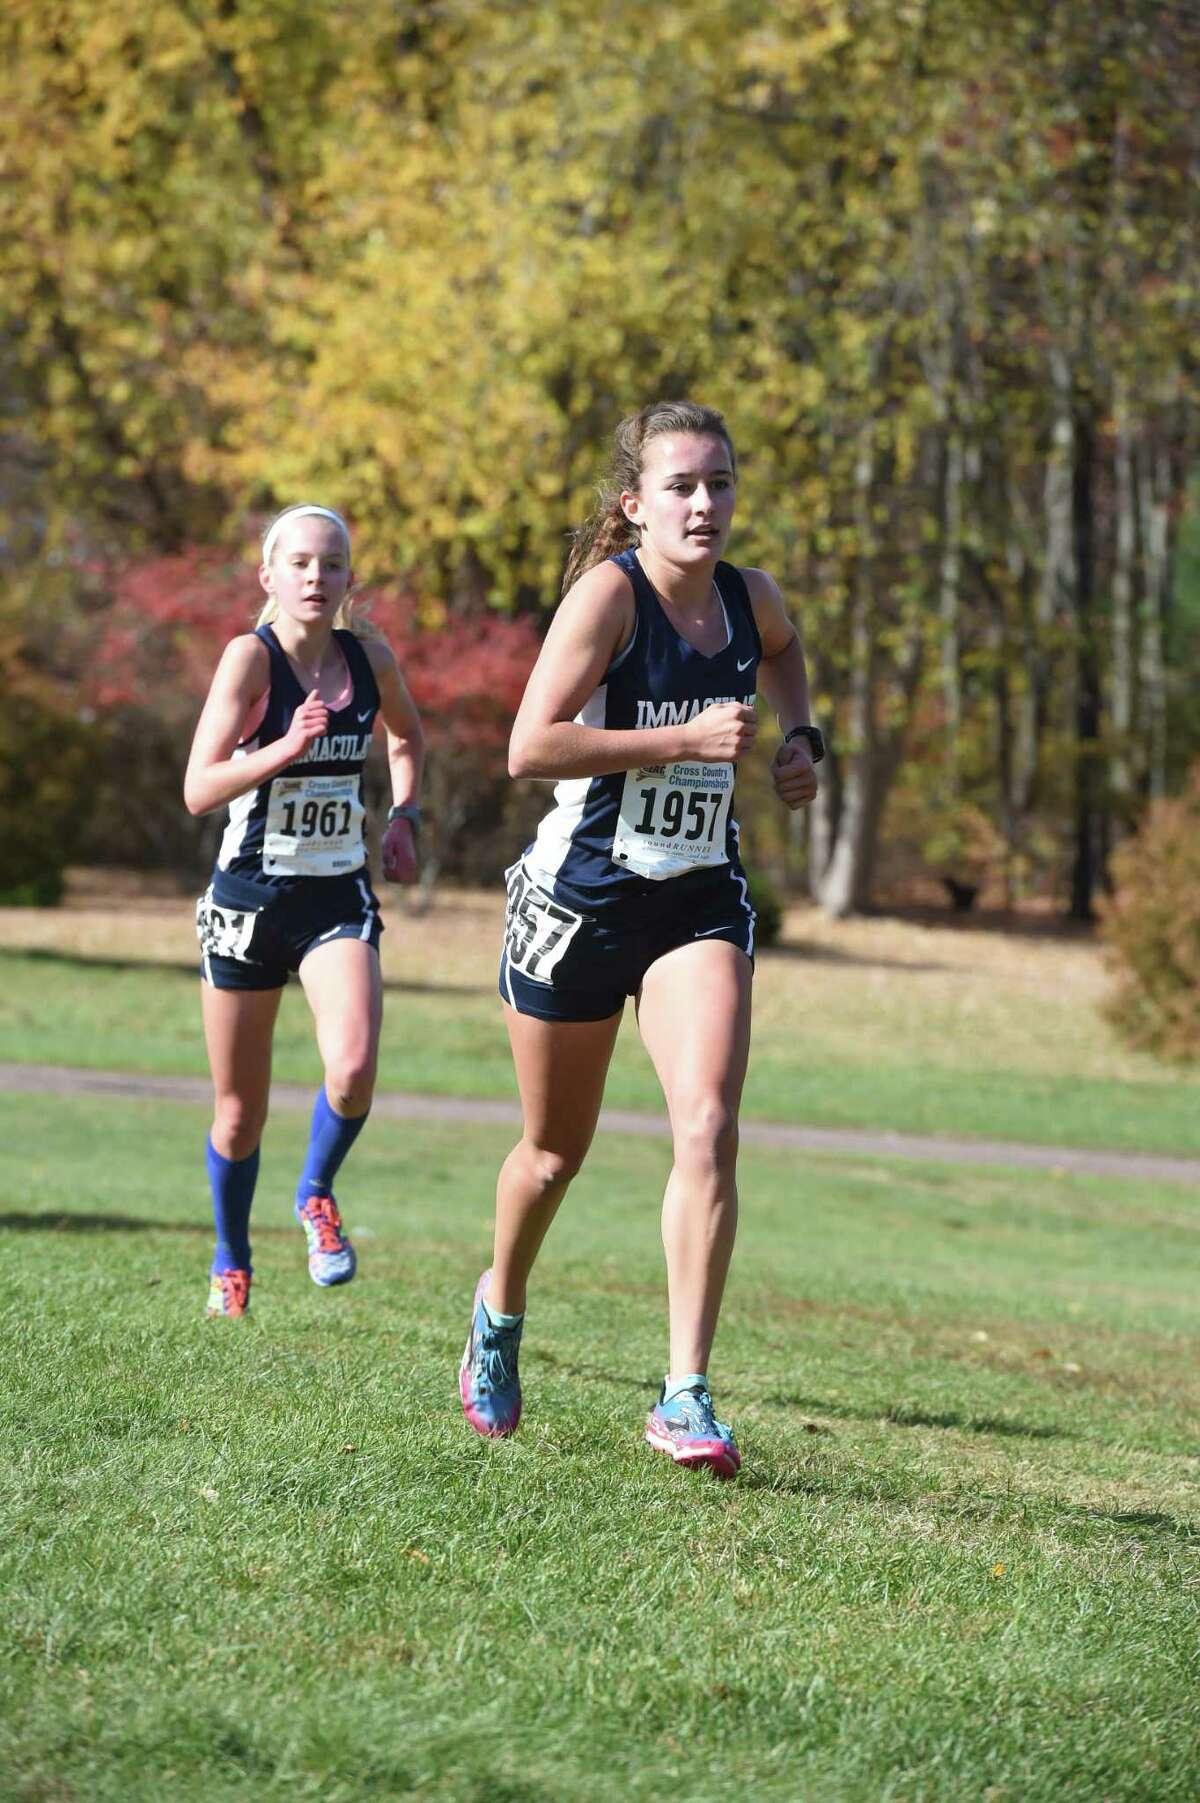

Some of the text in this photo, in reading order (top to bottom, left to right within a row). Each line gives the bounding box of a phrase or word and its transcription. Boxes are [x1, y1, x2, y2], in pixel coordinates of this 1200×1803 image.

[669, 775, 729, 790] Championships
[674, 764, 728, 779] Cross Country
[280, 800, 352, 838] 1961
[634, 787, 723, 842] 1957
